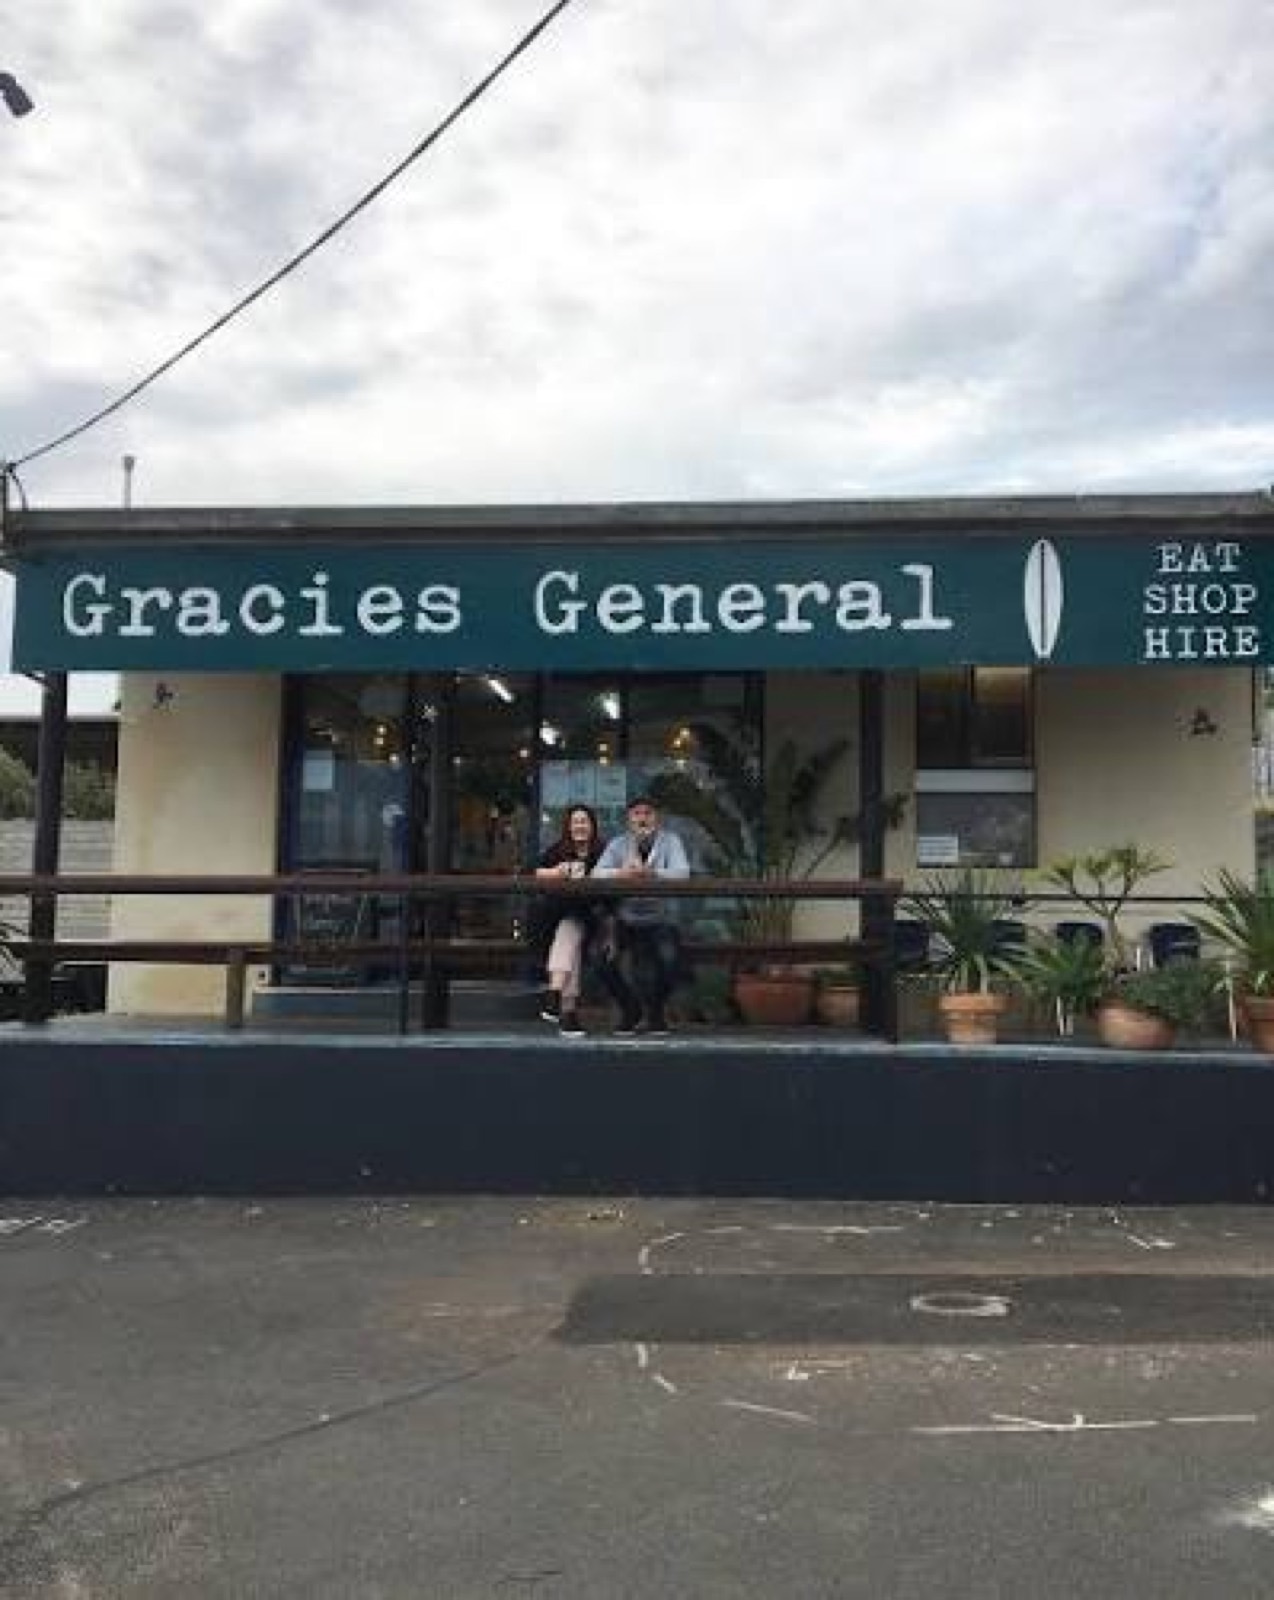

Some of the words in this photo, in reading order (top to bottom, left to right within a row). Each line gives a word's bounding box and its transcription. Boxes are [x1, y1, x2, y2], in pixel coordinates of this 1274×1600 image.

[1157, 542, 1241, 573] EAT
[62, 571, 463, 637] Gracies
[534, 564, 954, 635] General
[1144, 584, 1257, 614] SHOP
[1144, 627, 1260, 659] HIRE
